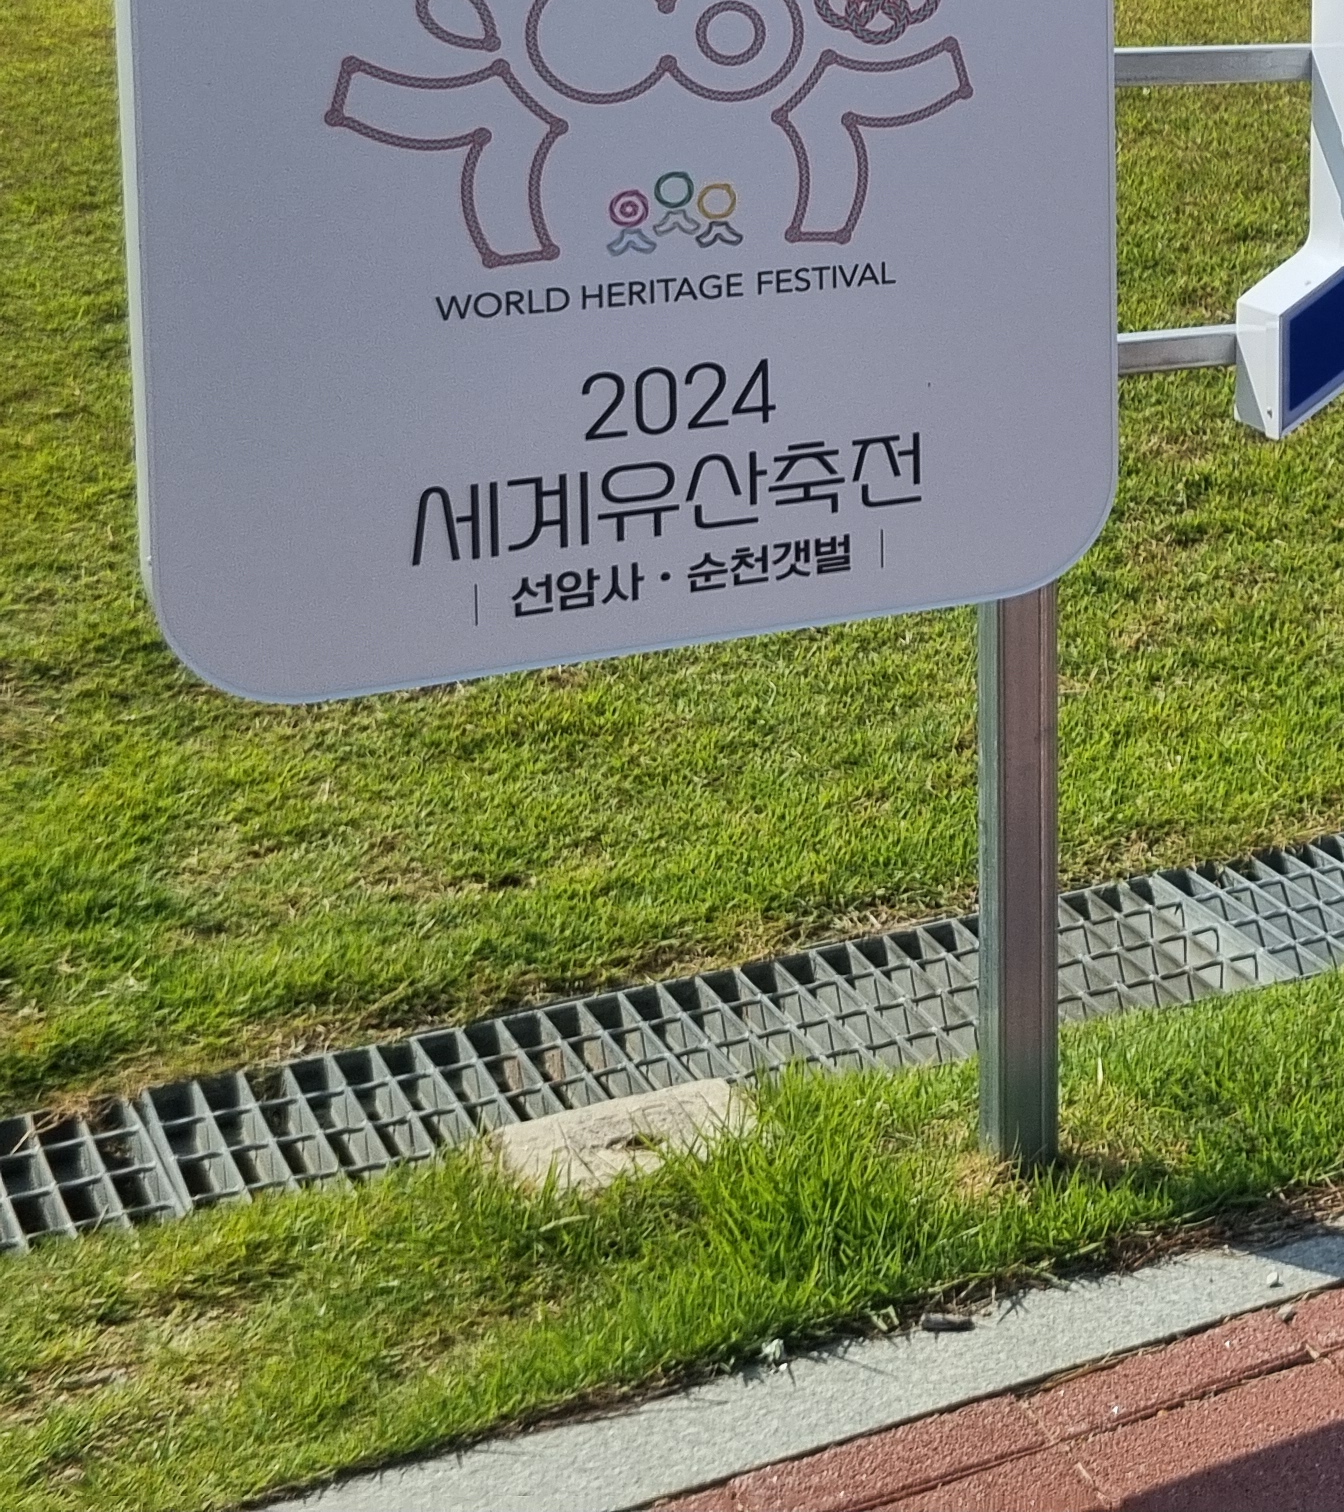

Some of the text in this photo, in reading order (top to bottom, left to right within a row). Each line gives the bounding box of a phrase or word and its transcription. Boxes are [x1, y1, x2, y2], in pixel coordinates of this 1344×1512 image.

[436, 262, 897, 322] WORLD HERITAGE FESTIVAL
[581, 358, 777, 441] 2024
[410, 432, 924, 567] 세계유산축전
[511, 561, 644, 618] 선암사
[687, 534, 853, 593] 순천갯벌
